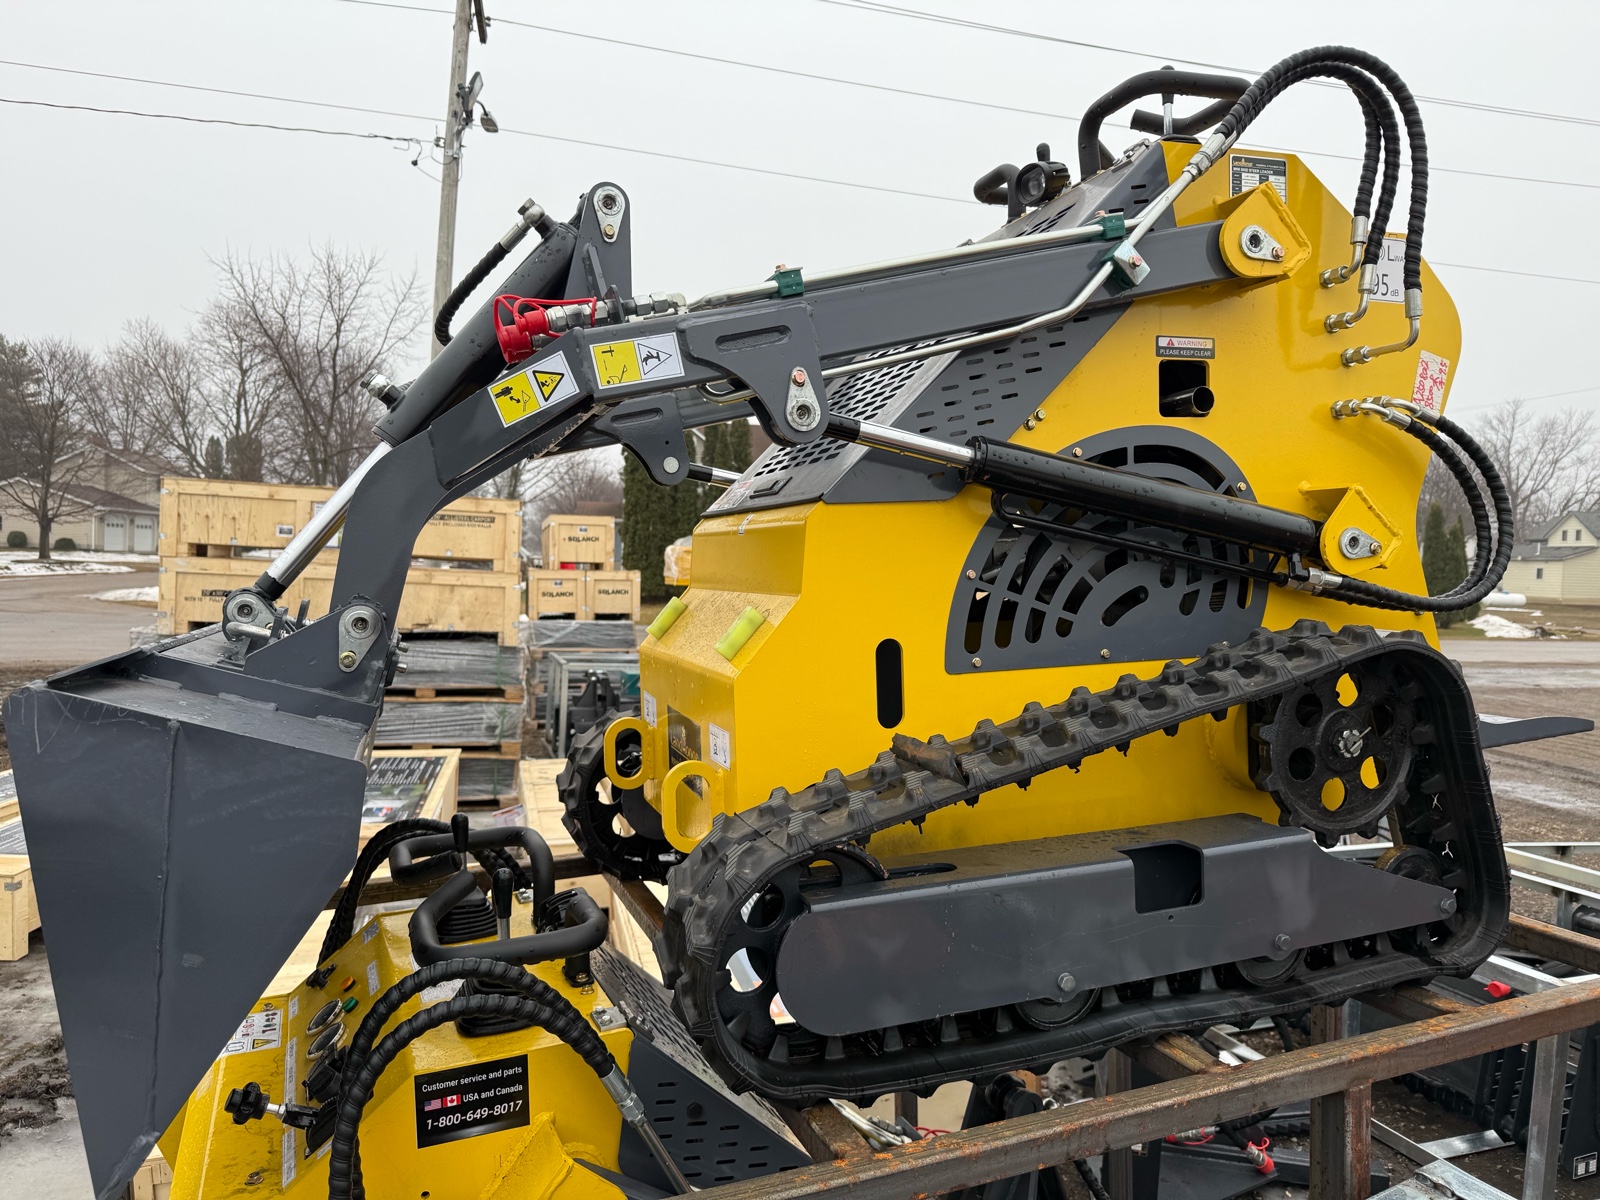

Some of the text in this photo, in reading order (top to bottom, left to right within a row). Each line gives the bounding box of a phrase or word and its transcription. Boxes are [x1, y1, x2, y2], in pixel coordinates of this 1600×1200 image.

[1390, 288, 1399, 296] dB
[421, 1066, 523, 1092] Customer service and parts
[462, 1083, 523, 1102] USA and Canada
[426, 1100, 523, 1130] 1-800-649-8017
